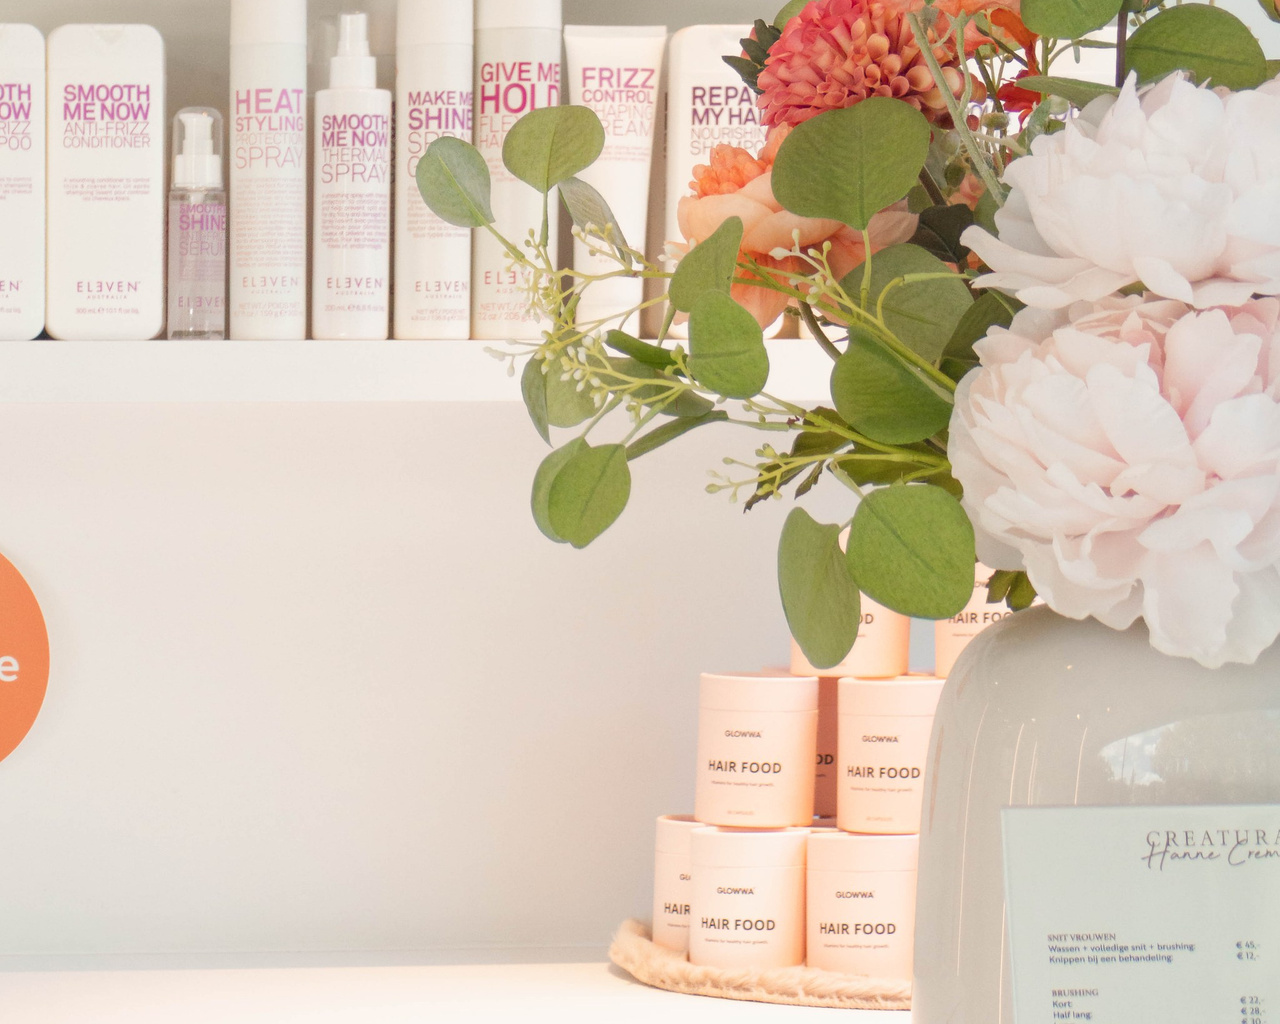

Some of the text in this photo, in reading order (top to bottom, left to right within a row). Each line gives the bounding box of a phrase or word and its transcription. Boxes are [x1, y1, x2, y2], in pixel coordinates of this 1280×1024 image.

[481, 62, 532, 82] GIVE
[582, 67, 655, 89] FRIZZ
[235, 89, 304, 115] HEAT
[408, 91, 456, 106] MAKE
[581, 89, 654, 105] CONTROL
[235, 116, 304, 132] STYLING
[322, 114, 388, 132] SMOOTH
[708, 760, 782, 775] HAIR FOOD
[847, 765, 920, 779] HAIR FOOD
[1141, 838, 1221, 871] Hanne
[664, 902, 690, 916] HAIR
[701, 917, 775, 932] HAIR FOOD
[820, 922, 896, 936] HAIR FOOD
[1048, 933, 1116, 942] SNIT VROUWEN
[1048, 945, 1080, 953] Wassen
[1090, 943, 1129, 954] volledige
[1131, 943, 1147, 951] snit
[1049, 955, 1086, 965] Knippen
[1088, 955, 1099, 965] bij
[1052, 989, 1099, 997] BRUSHING
[1053, 1011, 1071, 1019] Half
